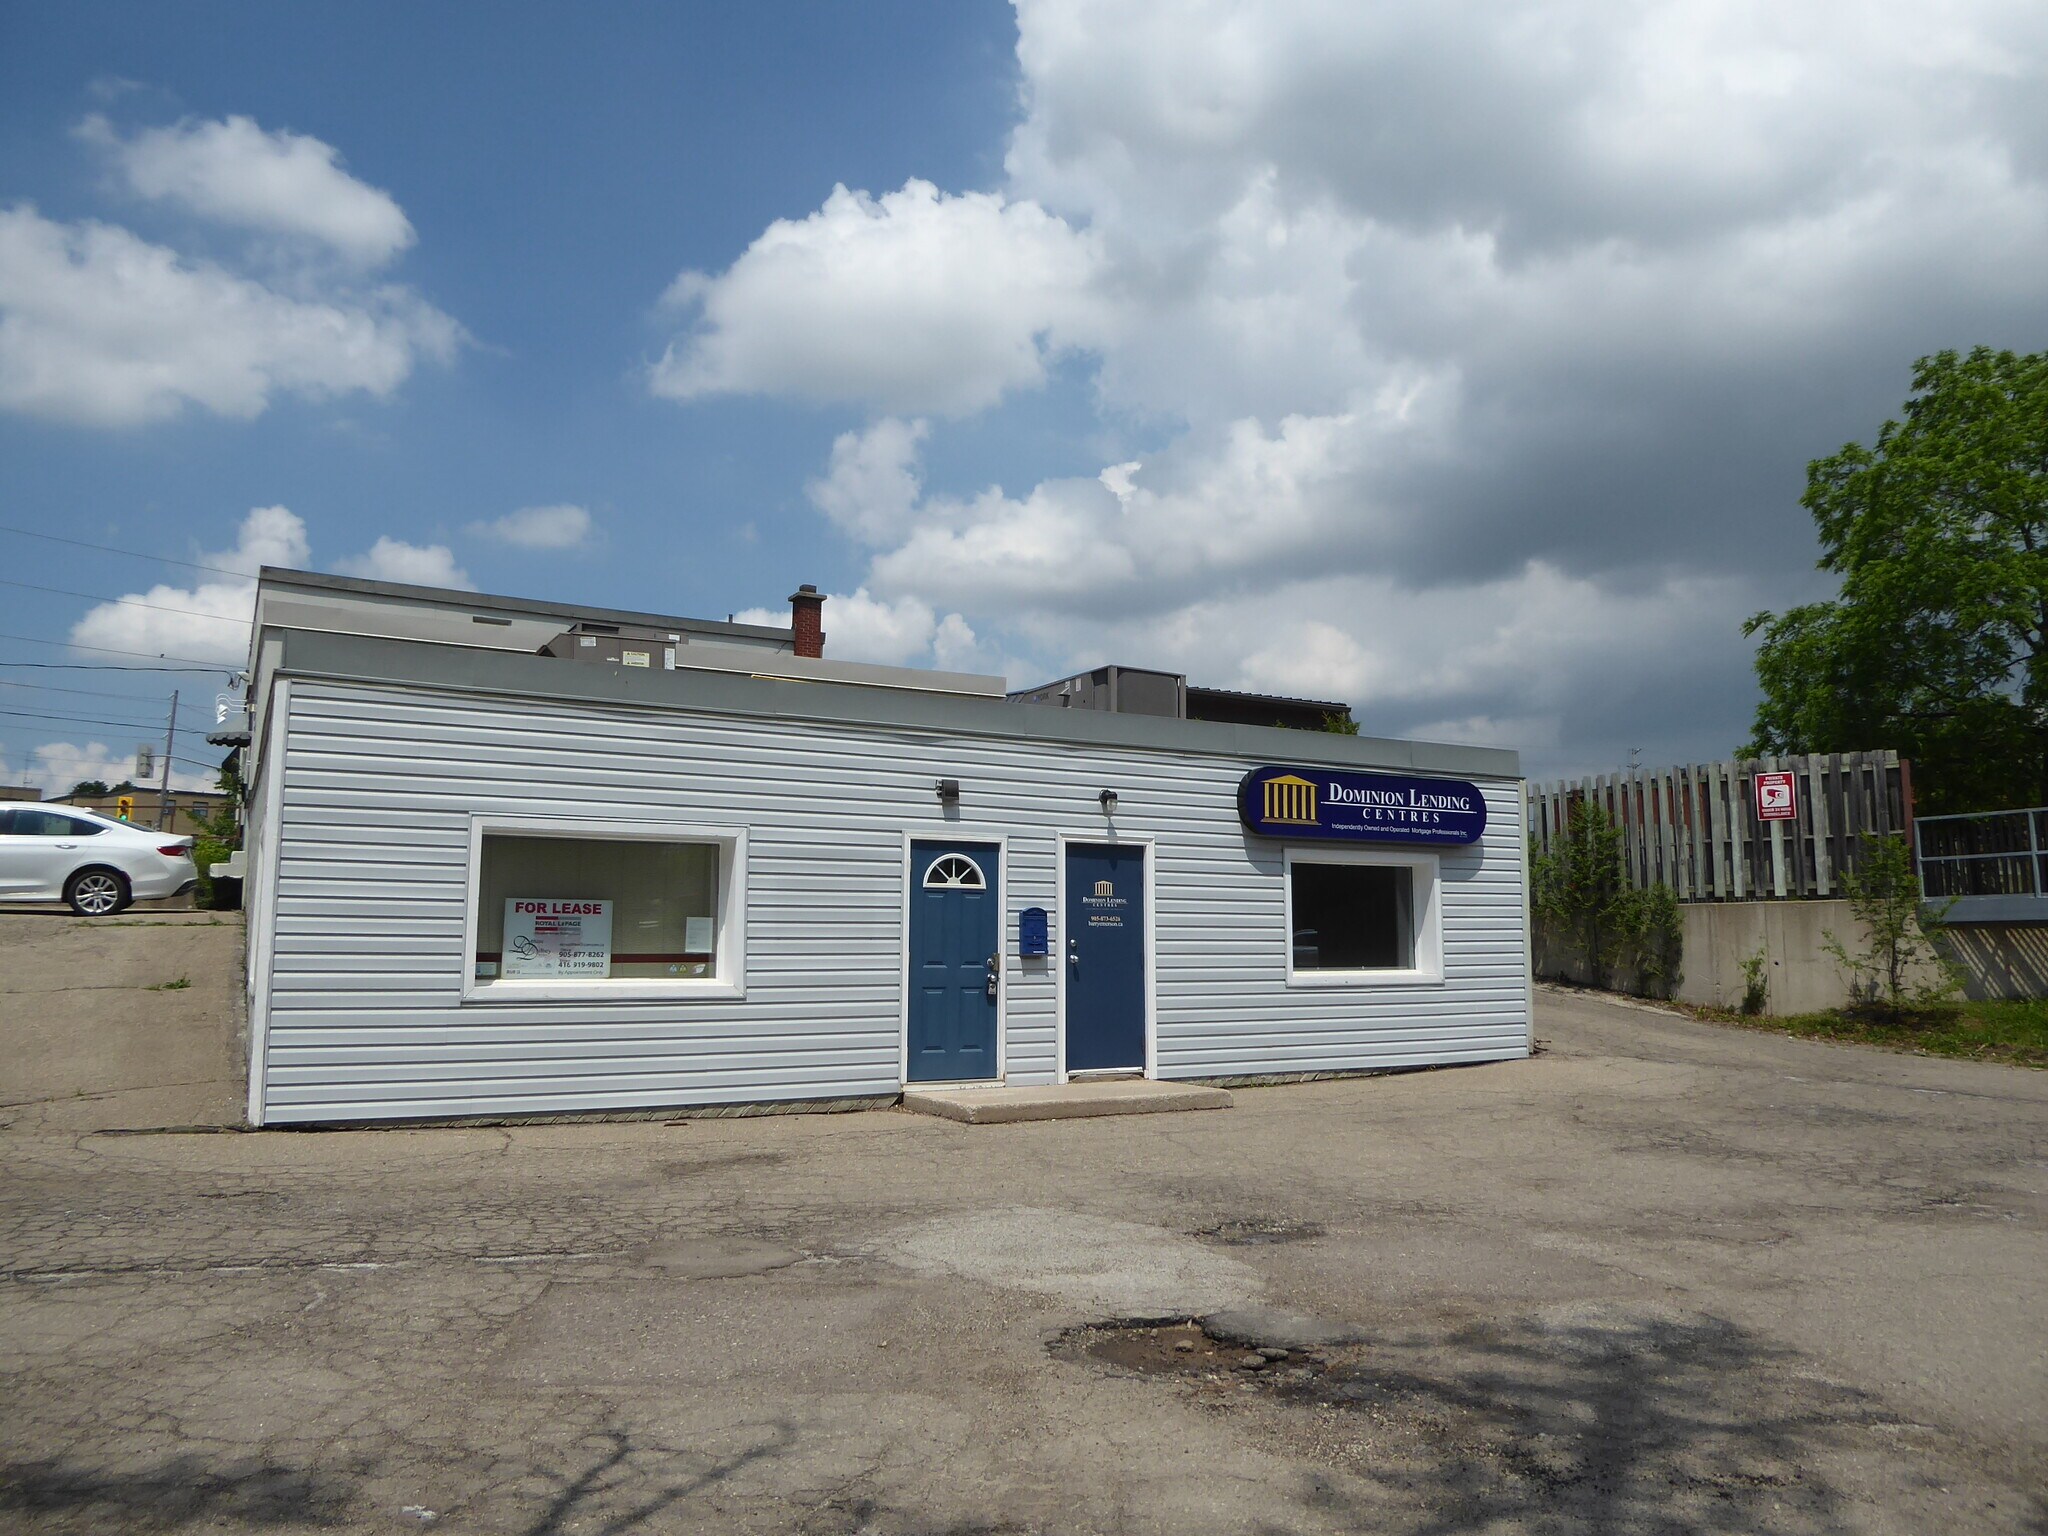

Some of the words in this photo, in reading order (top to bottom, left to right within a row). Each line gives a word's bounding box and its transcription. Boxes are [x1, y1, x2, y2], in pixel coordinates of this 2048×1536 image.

[1328, 782, 1404, 806] DOMINION
[1409, 788, 1470, 811] LENDING
[1362, 807, 1440, 824] CENTRES
[1331, 822, 1363, 832] Independently
[1363, 824, 1380, 832] Owned
[1411, 827, 1432, 836] Mortgage
[1432, 828, 1460, 836] Professionals
[515, 902, 547, 914] FOR
[552, 903, 602, 915] LEASE
